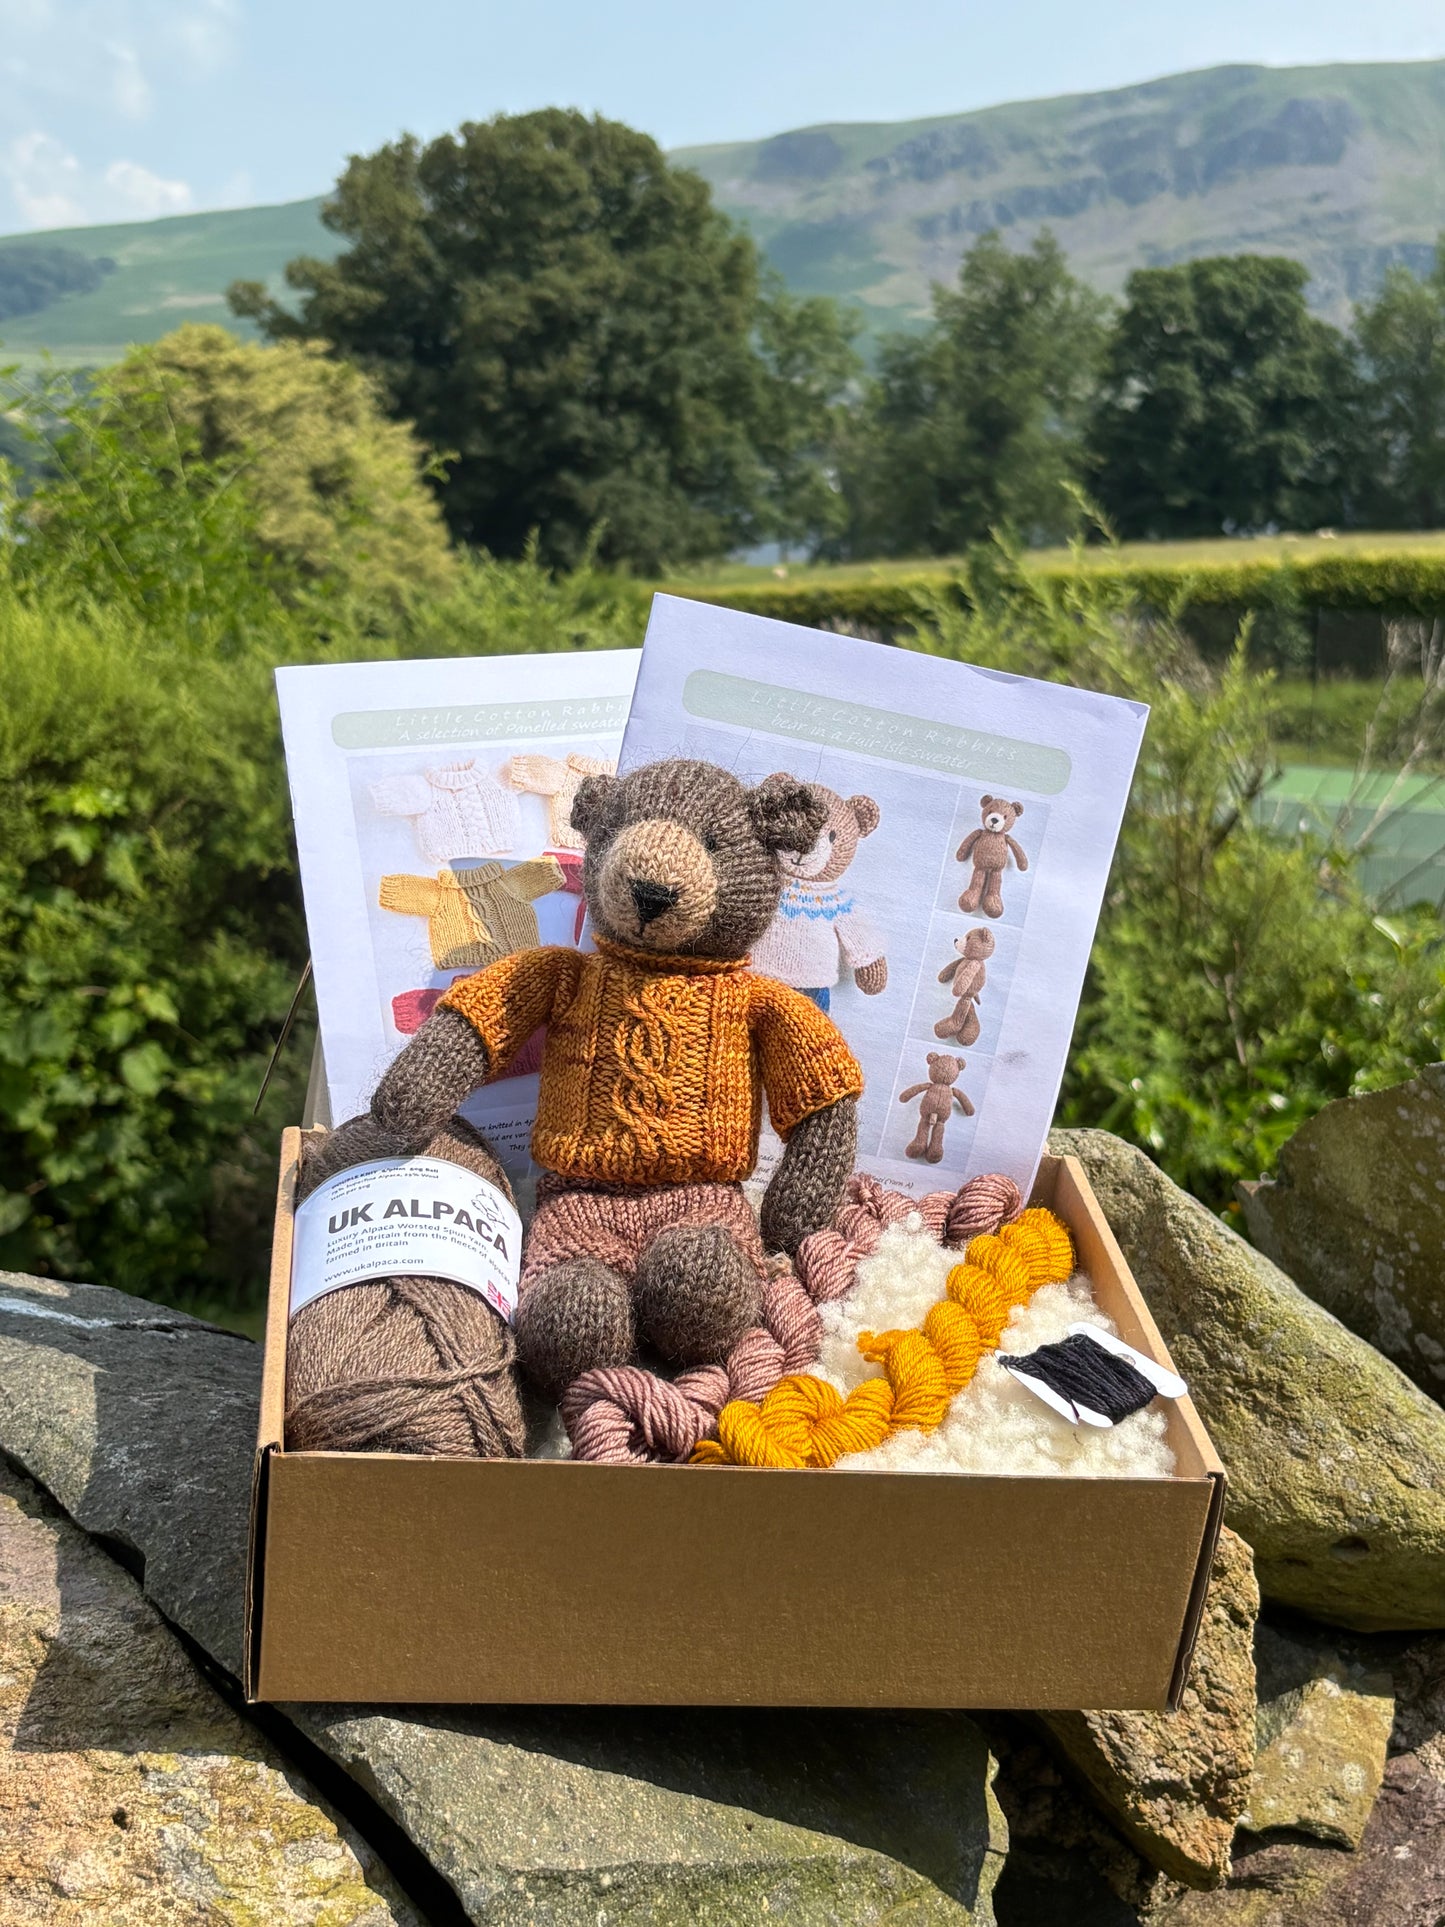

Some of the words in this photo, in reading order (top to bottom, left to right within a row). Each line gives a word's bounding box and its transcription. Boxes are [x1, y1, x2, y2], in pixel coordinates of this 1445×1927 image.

[395, 711, 465, 728] Little
[473, 708, 552, 724] Cotton
[561, 701, 625, 717] Rabbi
[750, 690, 825, 717] Little
[831, 709, 913, 738] Cotton
[923, 728, 1019, 762] Rabbits
[398, 729, 411, 742] A
[415, 726, 481, 741] selection
[485, 723, 504, 738] of
[504, 718, 566, 736] Panelled
[771, 711, 809, 731] bear
[810, 725, 827, 738] in
[830, 730, 842, 741] a
[846, 731, 881, 749] Fair
[911, 748, 970, 770] sweater
[488, 1120, 514, 1130] knitted
[509, 1144, 525, 1152] They
[327, 1231, 359, 1249] Luxury
[360, 1223, 395, 1236] Alpaca
[397, 1222, 440, 1232] Worsted
[442, 1226, 467, 1240] Spun
[328, 1201, 374, 1235] UK
[382, 1198, 510, 1264] ALPACA
[325, 1246, 360, 1266] farmed
[362, 1244, 373, 1252] in
[375, 1239, 409, 1249] Britain
[326, 1241, 353, 1257] Made
[355, 1237, 365, 1246] in
[367, 1231, 401, 1242] Britain
[403, 1230, 429, 1239] from
[431, 1232, 448, 1241] the
[450, 1235, 477, 1253] fleece
[478, 1249, 488, 1260] of
[488, 1257, 511, 1286] alpacas
[323, 1257, 425, 1283] www.ukalpaca.com
